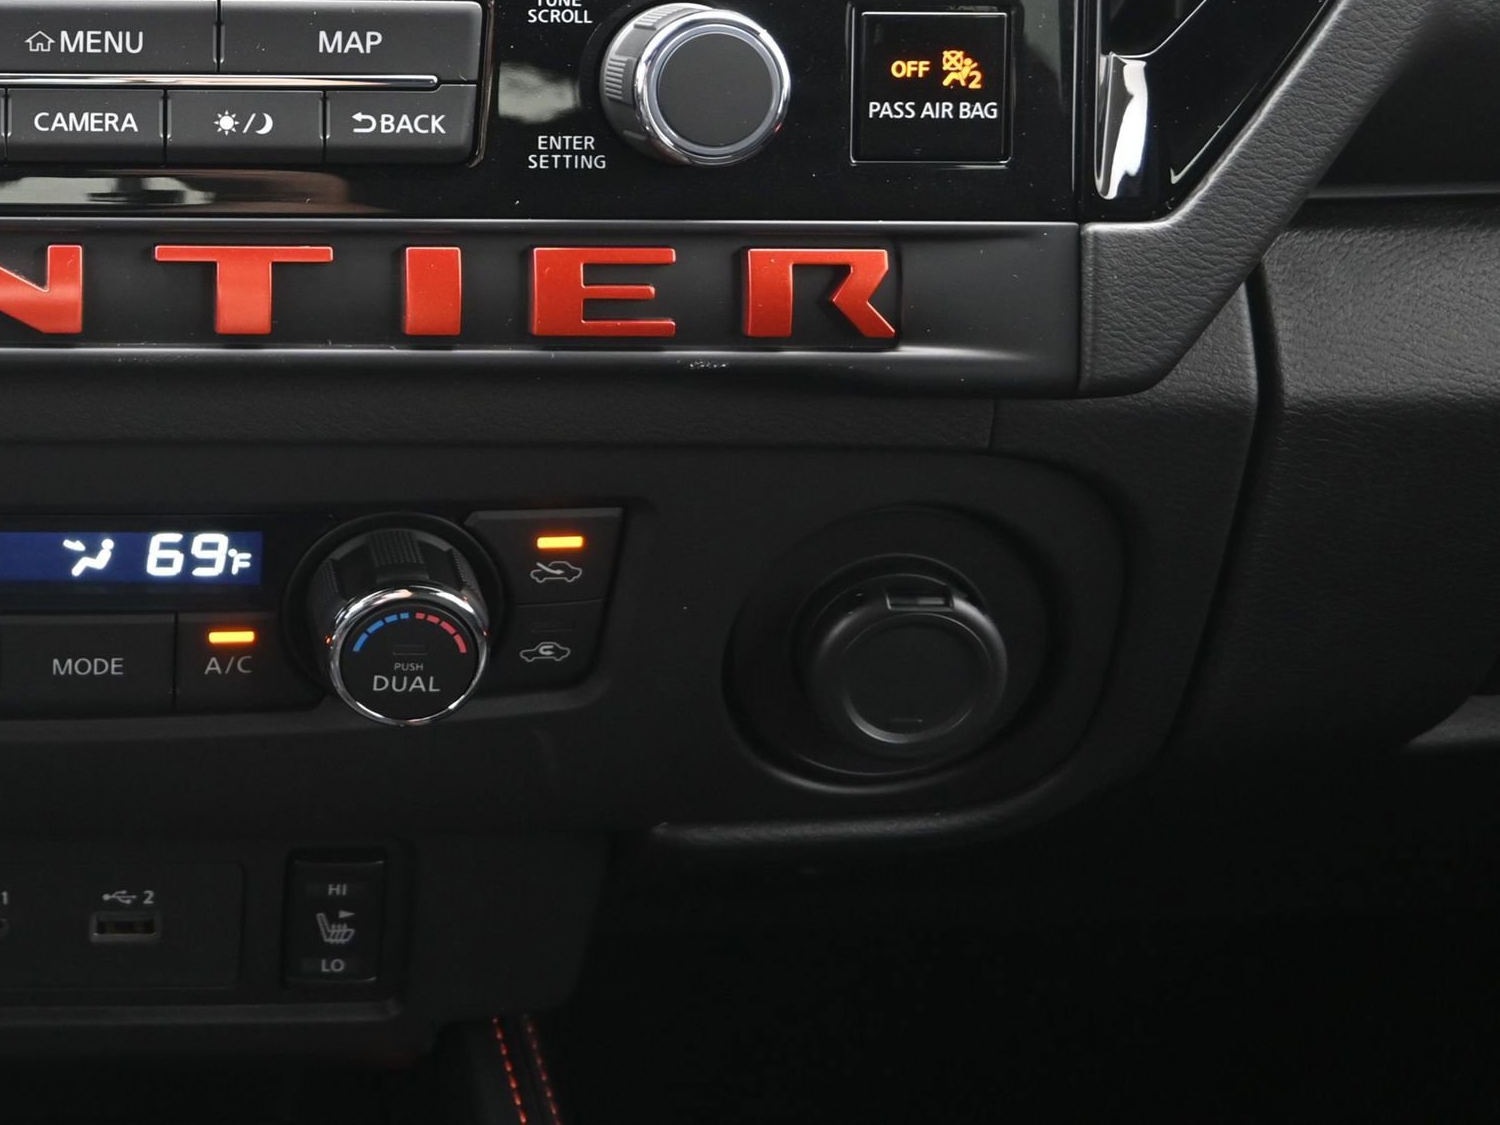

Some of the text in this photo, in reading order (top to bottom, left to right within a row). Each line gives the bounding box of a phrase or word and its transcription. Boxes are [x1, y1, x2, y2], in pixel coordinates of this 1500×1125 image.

[528, 8, 593, 24] SCROLL
[60, 30, 144, 54] MENU
[318, 31, 382, 54] MAP
[891, 60, 930, 78] OFF
[869, 102, 997, 119] PASS AIR BAG
[34, 112, 139, 133] CAMERA
[380, 114, 445, 134] BACK
[537, 136, 595, 151] ENTER
[528, 154, 606, 169] SETTING
[52, 657, 124, 676] MODE
[204, 656, 252, 675] A/C
[395, 663, 423, 671] PUSH
[373, 675, 441, 693] DUAL
[1, 892, 8, 905] 1
[143, 891, 154, 905] 2
[328, 884, 347, 896] HI
[321, 960, 344, 972] LO
